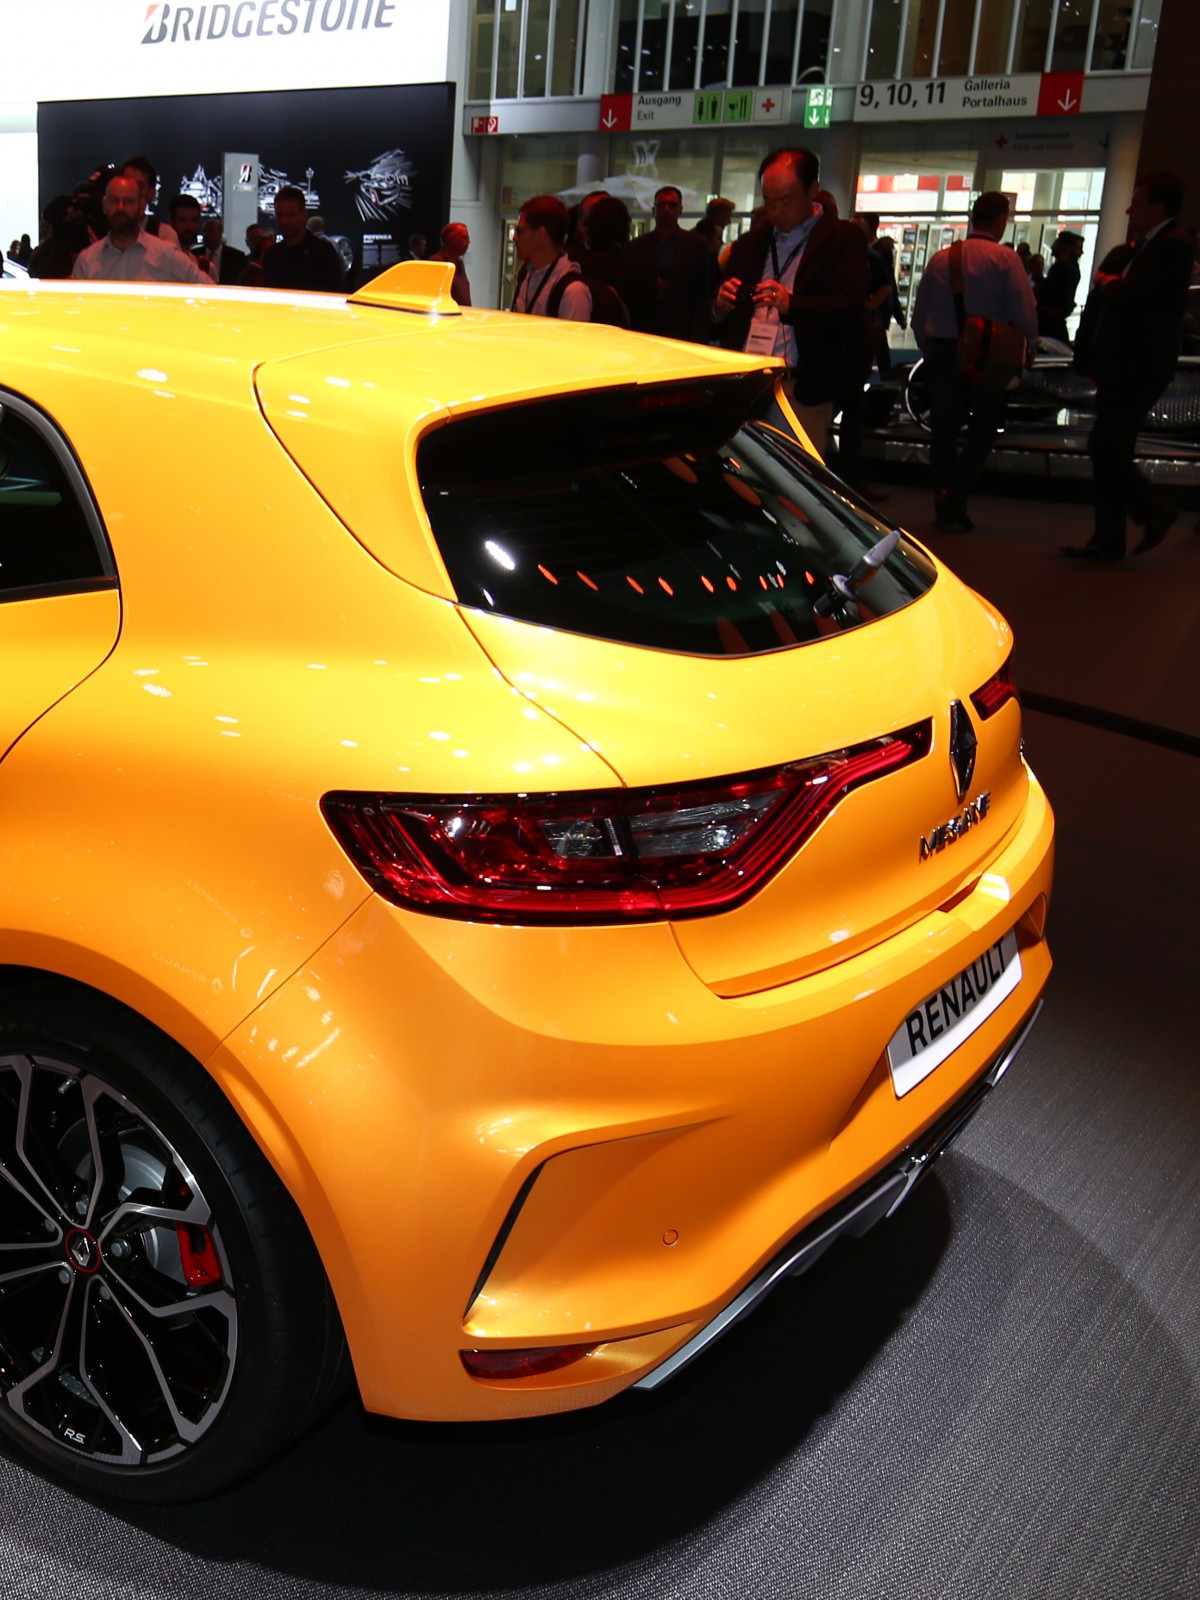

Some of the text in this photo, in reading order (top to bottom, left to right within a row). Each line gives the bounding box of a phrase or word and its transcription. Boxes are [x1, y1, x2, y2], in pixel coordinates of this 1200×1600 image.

[141, 0, 396, 44] BRIDGESTONE
[964, 79, 1010, 92] Galleria
[925, 82, 946, 104] 11
[638, 95, 682, 107] Ausgang
[962, 95, 1027, 108] Portalhaus
[637, 110, 654, 121] Exit
[905, 938, 1006, 1057] RENAULT
